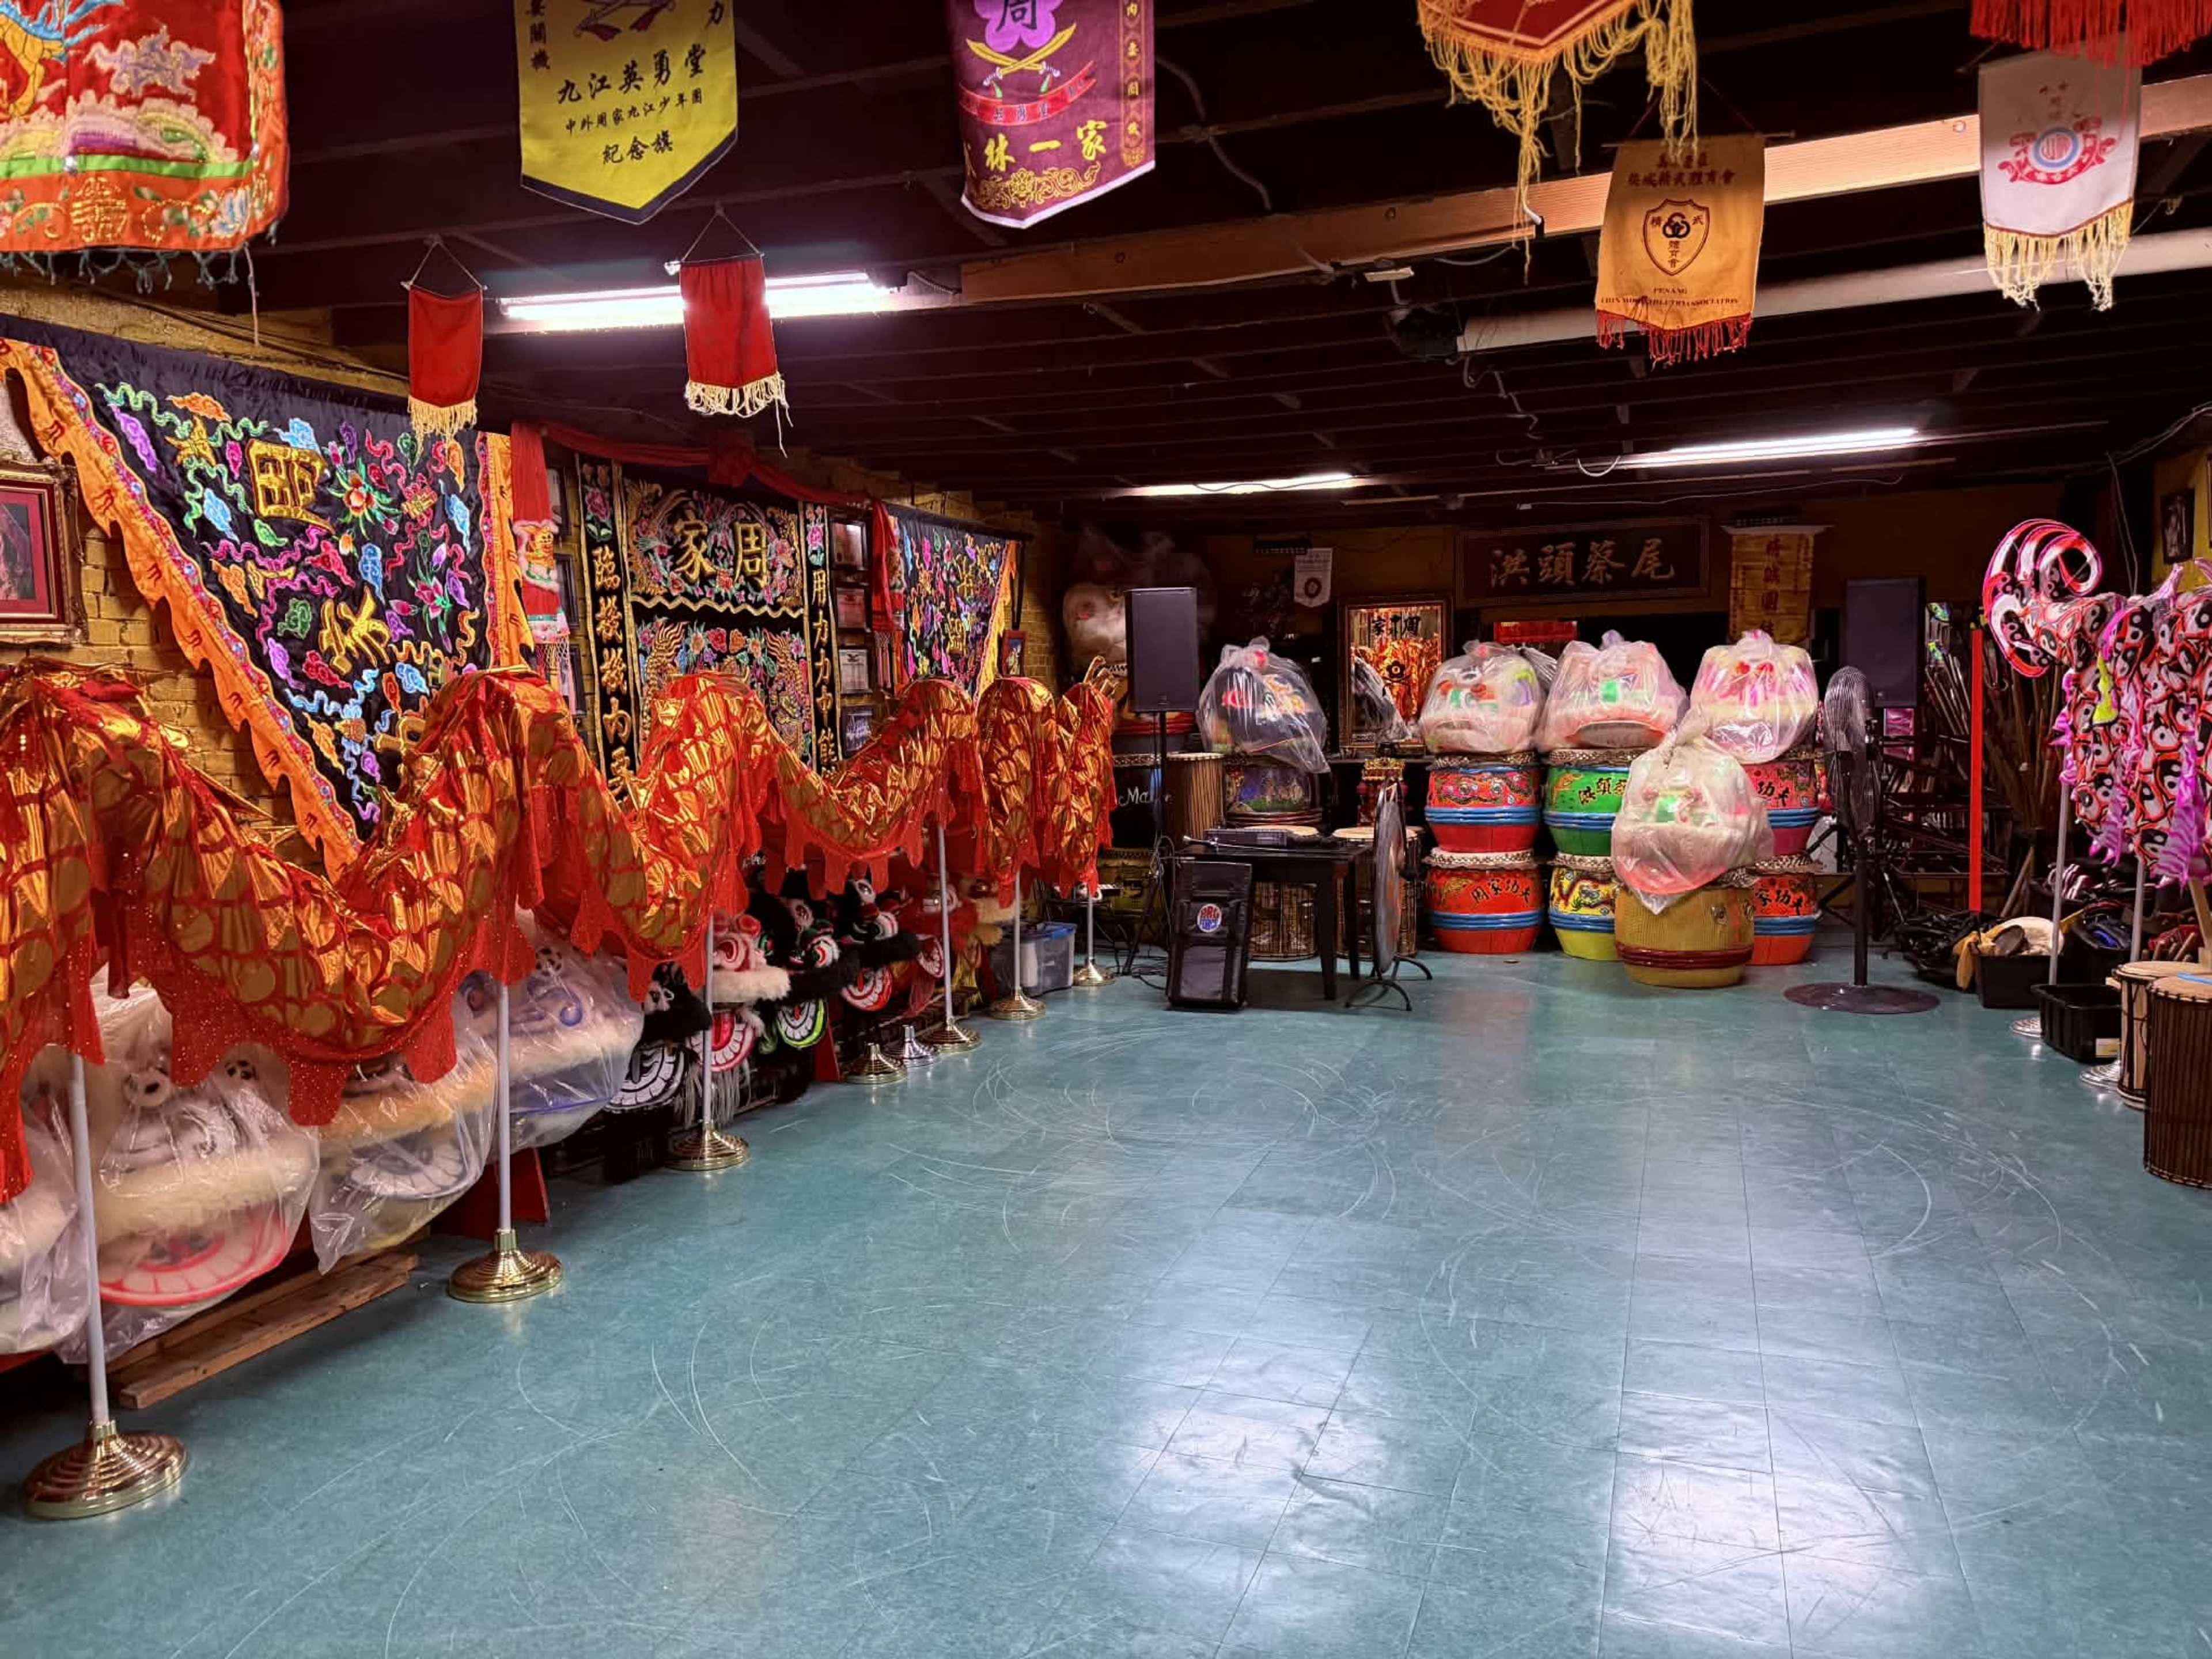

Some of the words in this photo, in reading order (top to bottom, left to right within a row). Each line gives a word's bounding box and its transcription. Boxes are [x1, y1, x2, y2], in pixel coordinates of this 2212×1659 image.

[558, 43, 707, 104] 九江英勇堂
